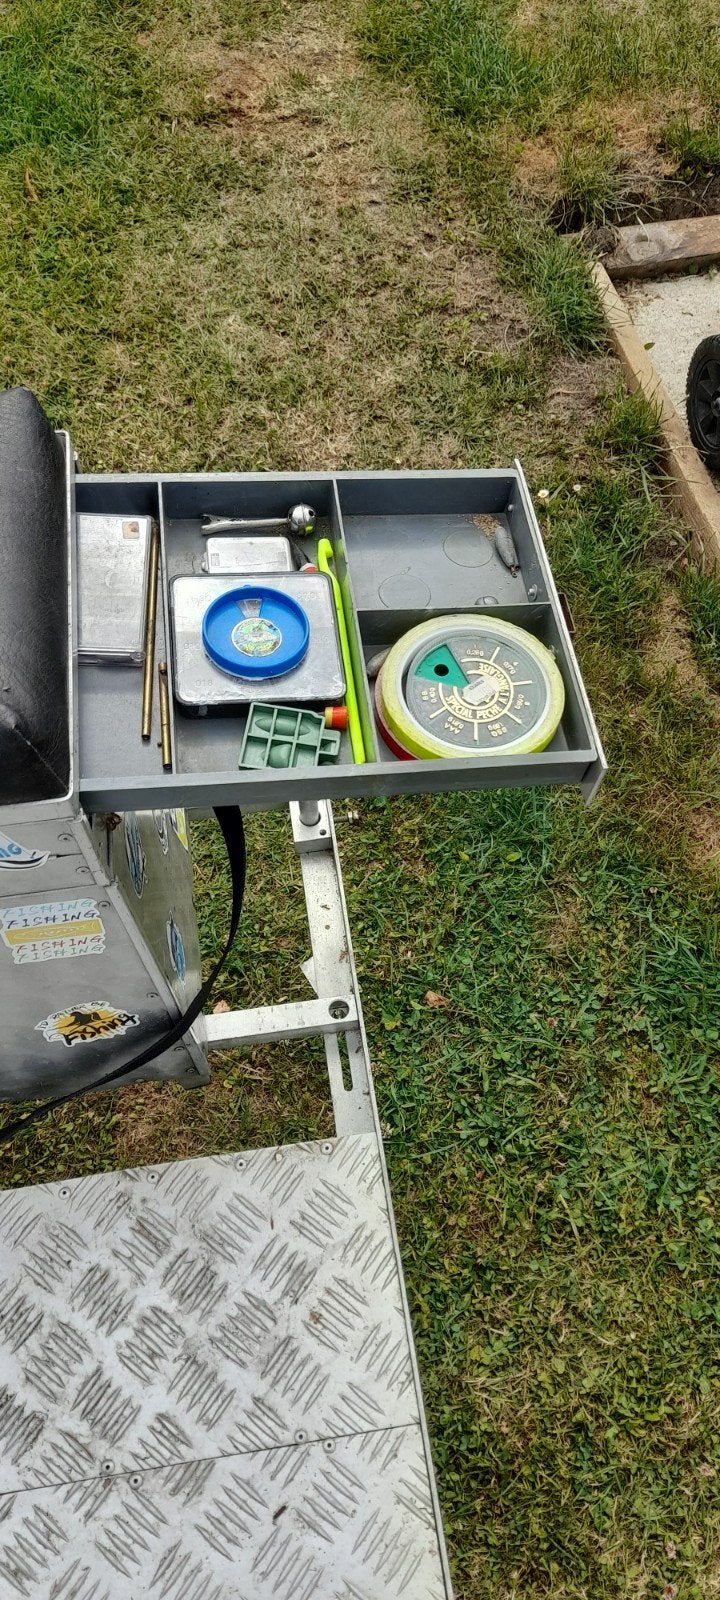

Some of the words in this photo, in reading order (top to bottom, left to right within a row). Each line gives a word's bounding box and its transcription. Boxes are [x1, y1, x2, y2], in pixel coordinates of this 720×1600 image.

[444, 695, 473, 719] SPECIAL
[444, 722, 462, 735] AAA
[3, 900, 93, 918] FISHING
[7, 909, 99, 929] FISHING
[16, 934, 105, 954] FISHING
[18, 945, 105, 963] FISHING
